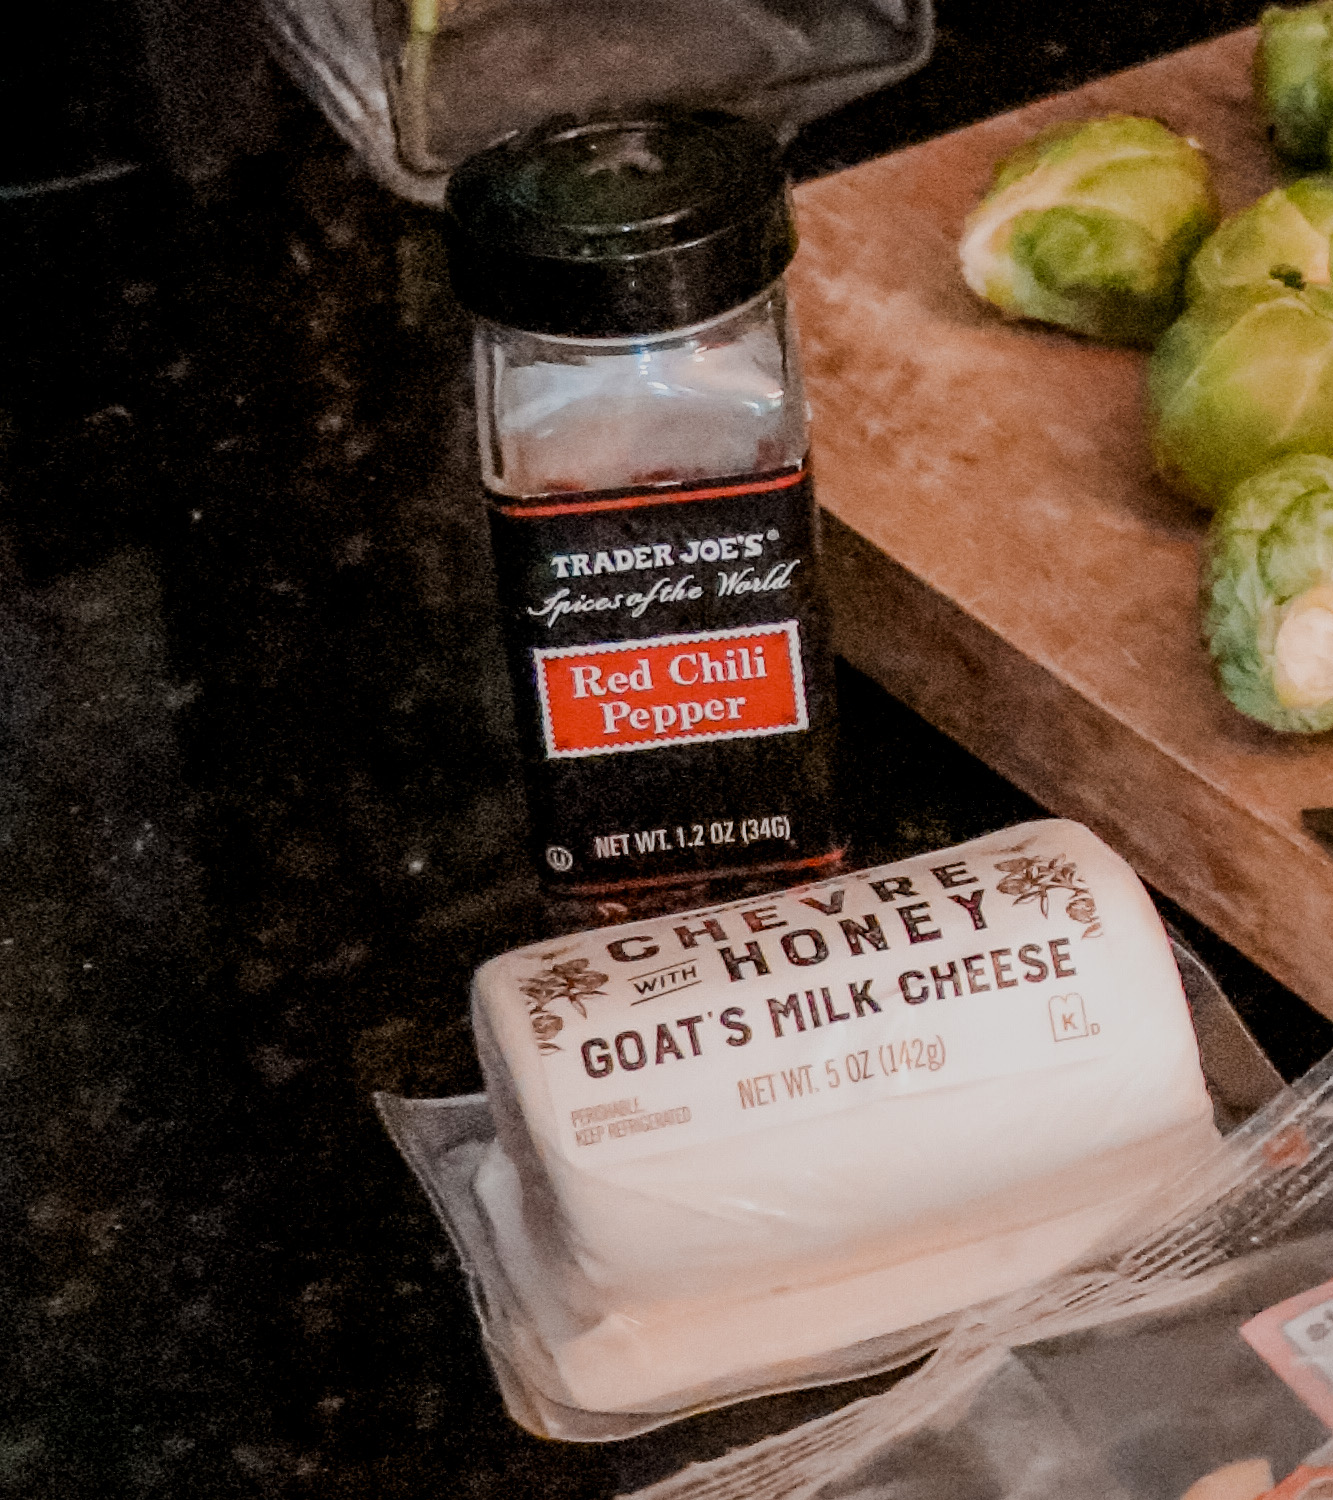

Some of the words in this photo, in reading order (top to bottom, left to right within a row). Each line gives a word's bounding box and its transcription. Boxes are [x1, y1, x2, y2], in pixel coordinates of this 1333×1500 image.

[551, 544, 675, 578] TRADER
[679, 533, 765, 564] JOE'S
[528, 588, 621, 627] Spices
[624, 577, 671, 618] of
[658, 575, 704, 603] the
[717, 558, 801, 597] World
[569, 658, 654, 699] Red
[668, 645, 768, 686] Chili
[599, 696, 747, 734] Pepper
[593, 833, 630, 859] NET
[634, 829, 673, 854] WT.
[676, 824, 705, 849] 1.2
[710, 821, 736, 845] OZ
[741, 815, 792, 845] (34G)
[606, 860, 980, 963] CHEVRE
[633, 965, 698, 996] WITH
[717, 889, 989, 982] HONEY
[580, 1006, 752, 1079] GOAT'S
[766, 979, 882, 1039] MILK
[898, 937, 1077, 1005] CHEESE
[736, 1073, 778, 1110] NET
[780, 1064, 820, 1100] WT.
[825, 1059, 841, 1089] 5
[845, 1049, 875, 1083] OZ
[877, 1034, 947, 1078] (142g)
